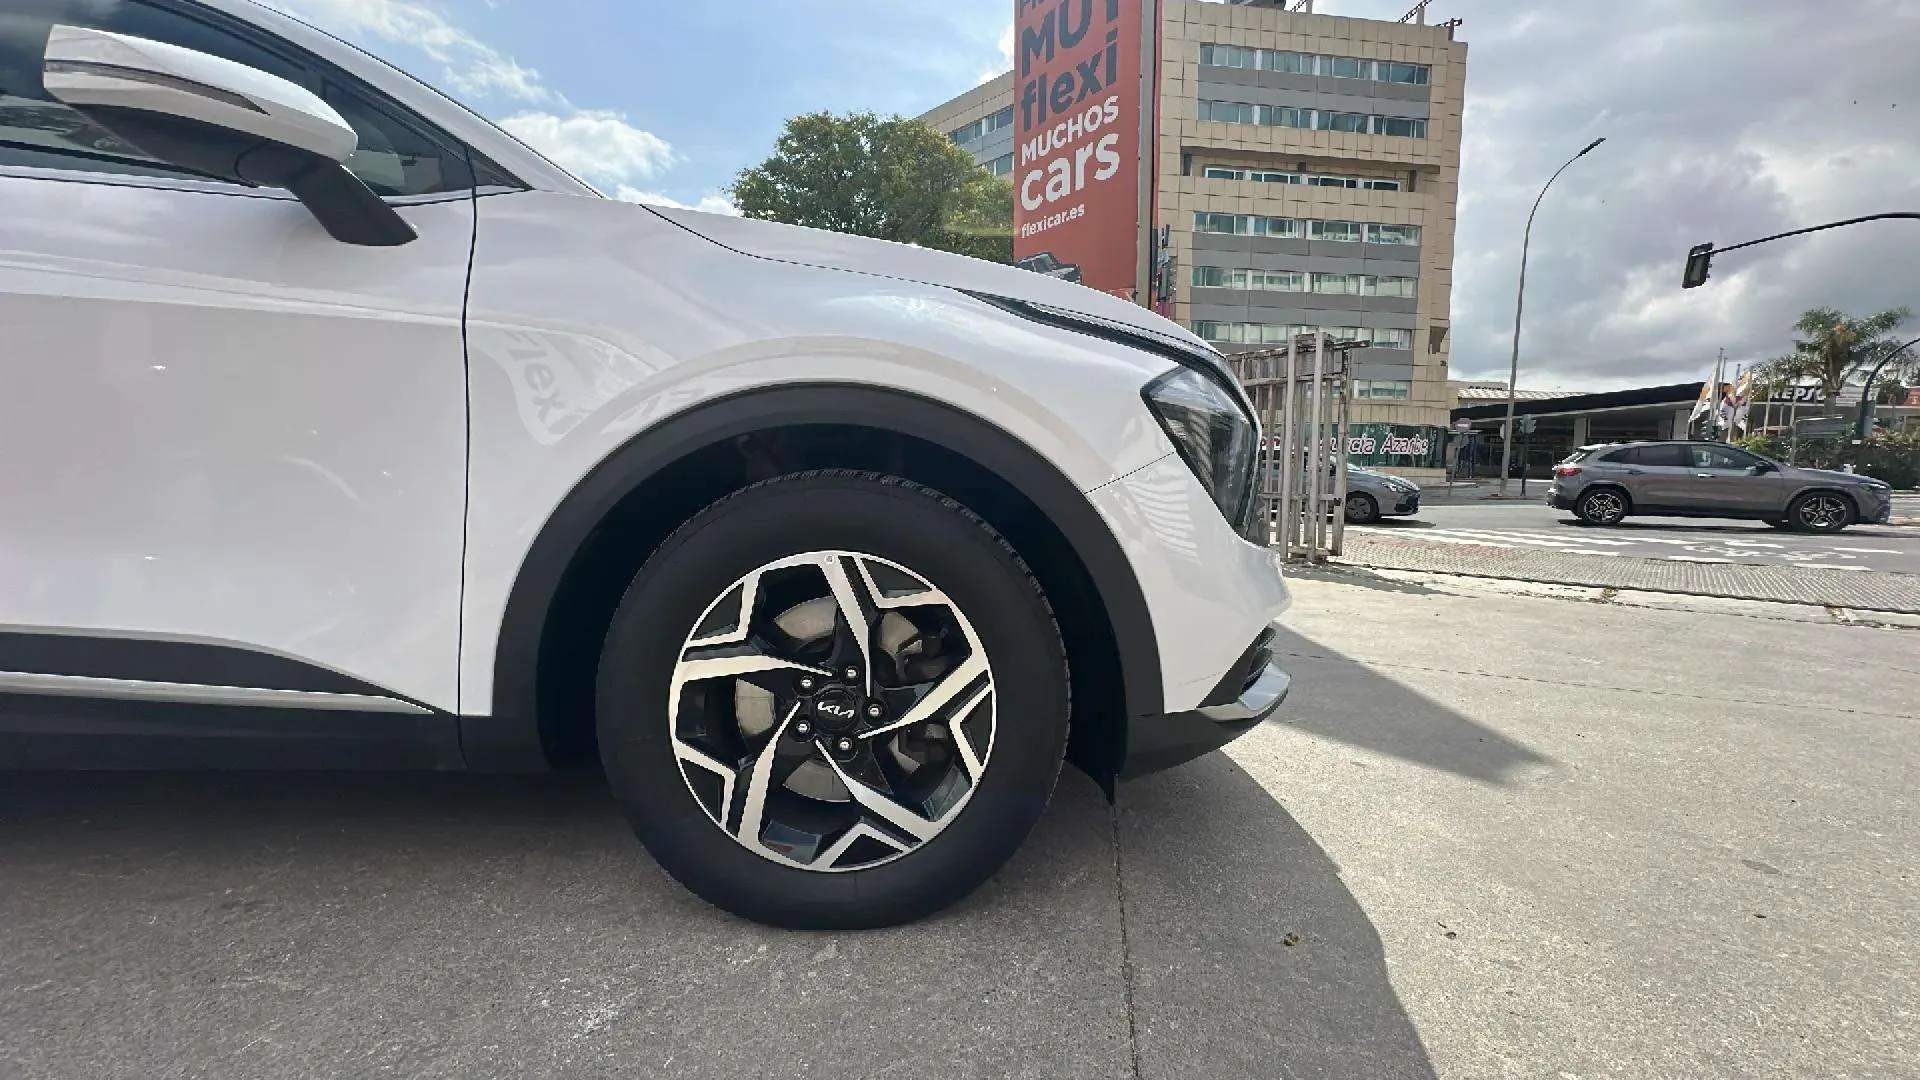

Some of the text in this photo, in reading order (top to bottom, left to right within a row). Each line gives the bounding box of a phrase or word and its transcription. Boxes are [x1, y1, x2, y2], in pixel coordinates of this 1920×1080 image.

[1020, 27, 1118, 132] flexi
[1021, 95, 1119, 166] MUCHOS
[1020, 133, 1120, 211] cars
[1021, 203, 1085, 239] flexicar.es
[817, 701, 855, 719] KIA
